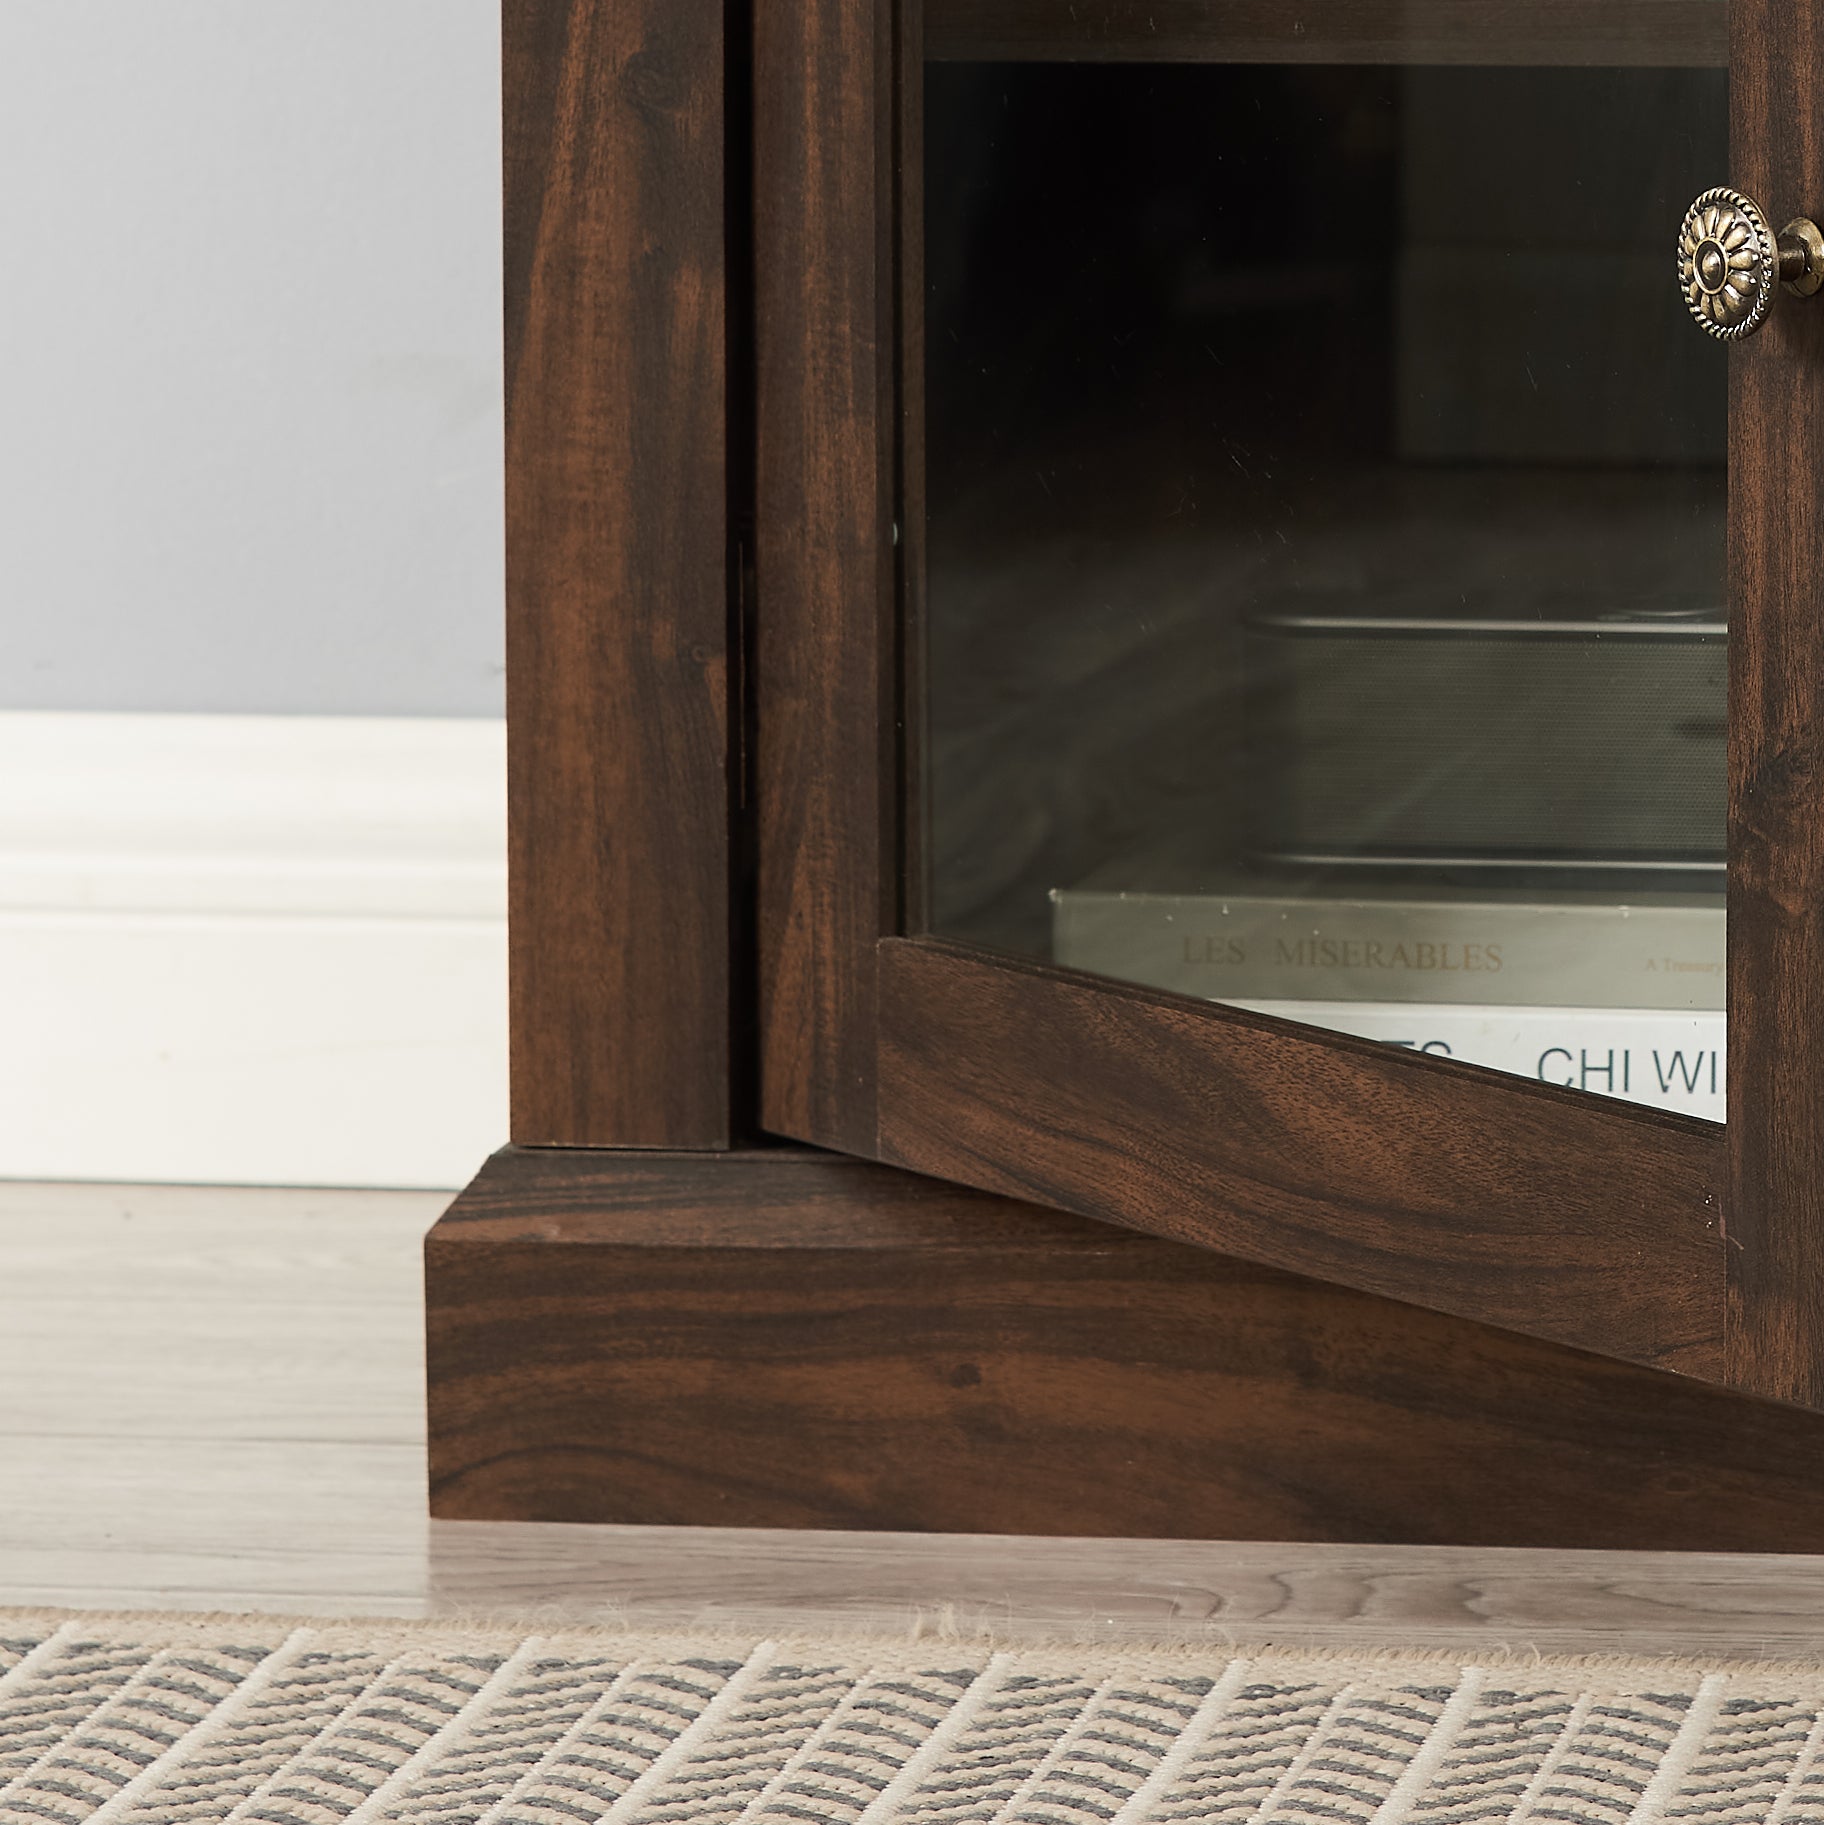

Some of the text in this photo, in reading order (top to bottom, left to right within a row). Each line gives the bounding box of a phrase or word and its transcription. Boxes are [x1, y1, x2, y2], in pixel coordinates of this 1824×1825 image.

[1181, 935, 1504, 973] LES MISERABLES
[1644, 957, 1658, 972] A
[1537, 1047, 1630, 1094] CHI
